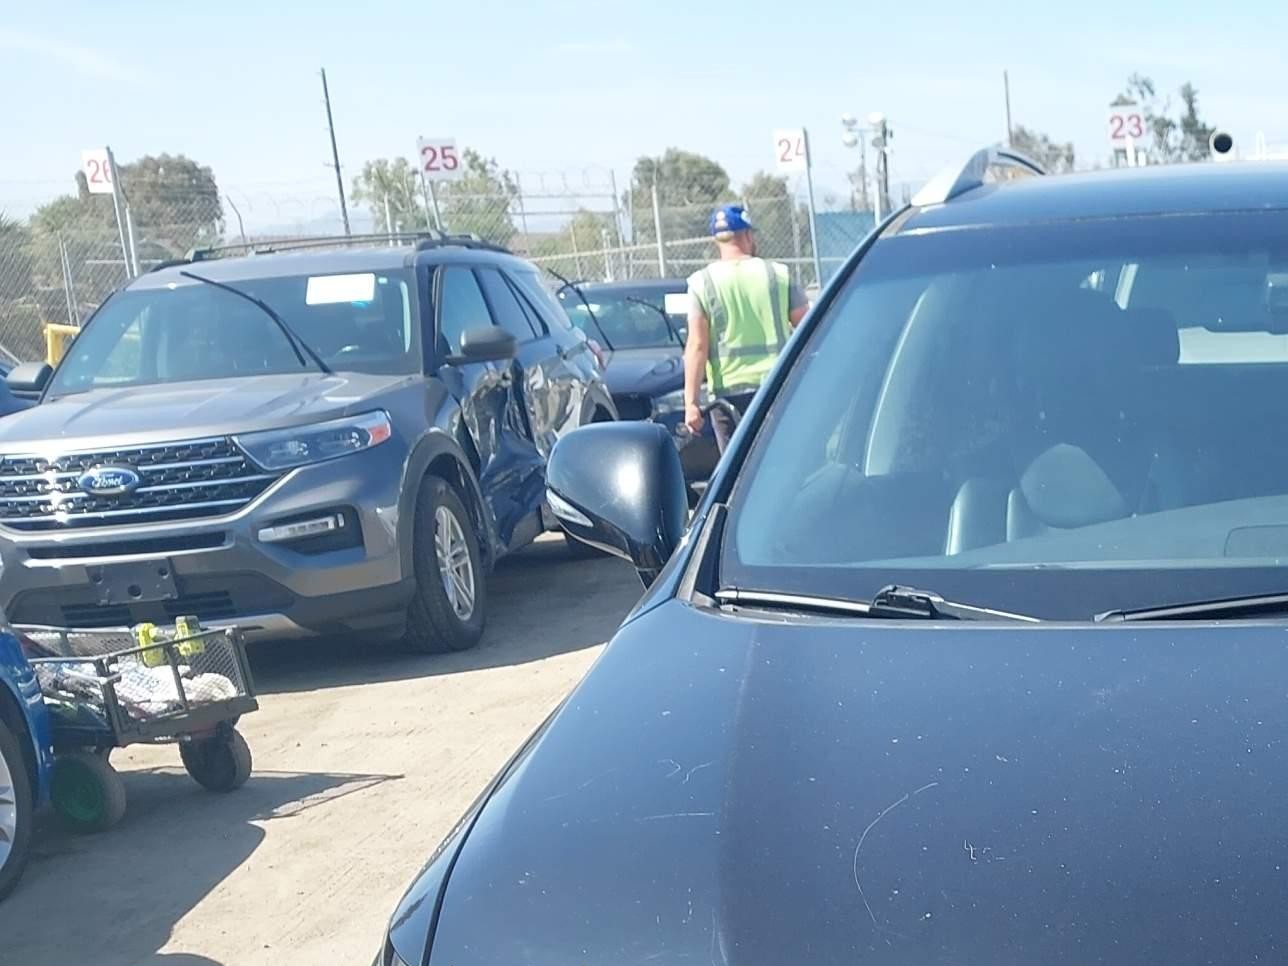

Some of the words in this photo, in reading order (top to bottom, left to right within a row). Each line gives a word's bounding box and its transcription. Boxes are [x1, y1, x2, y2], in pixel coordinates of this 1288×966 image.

[1109, 114, 1143, 140] 23
[421, 145, 459, 172] 25
[91, 472, 123, 489] Ford
